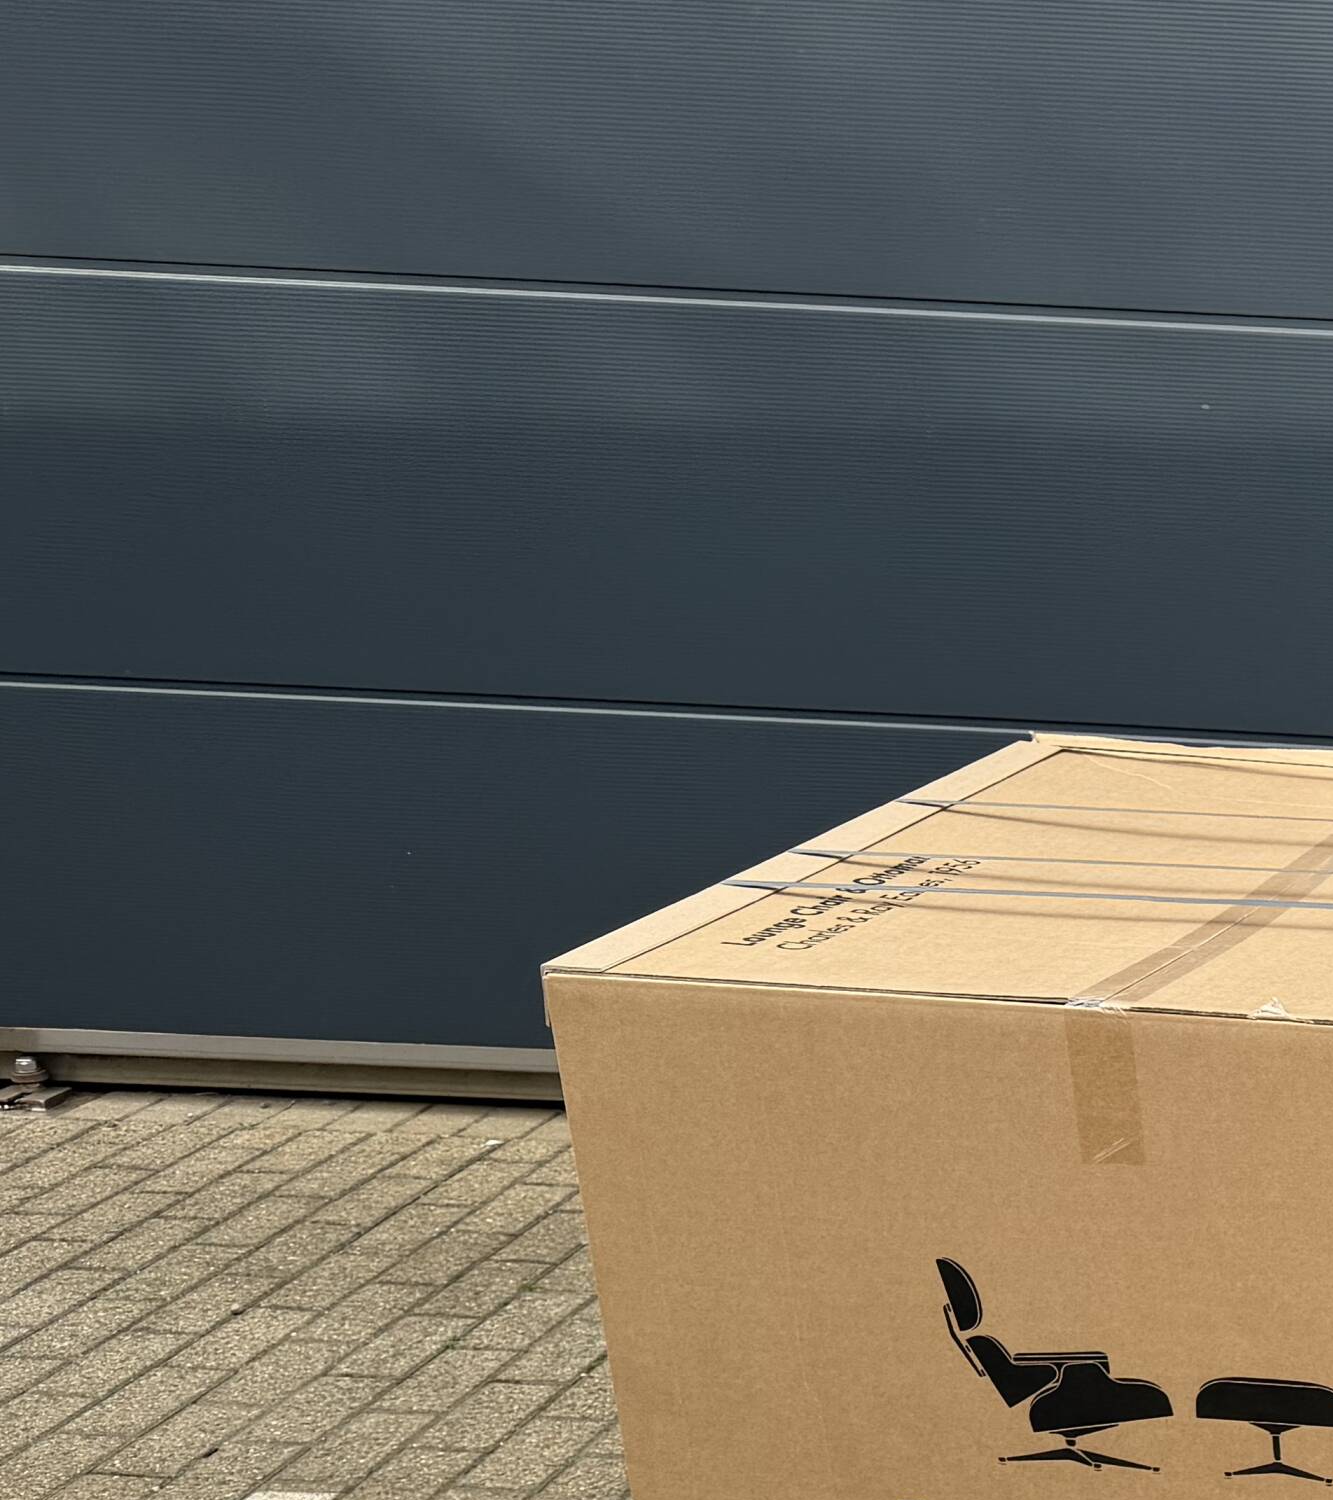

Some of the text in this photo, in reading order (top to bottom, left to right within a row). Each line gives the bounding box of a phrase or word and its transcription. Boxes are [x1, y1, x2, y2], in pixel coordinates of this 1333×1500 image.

[720, 917, 807, 946] Lounge
[789, 894, 853, 915] Chair
[776, 924, 856, 950] Charles
[851, 901, 905, 916] Ray
[927, 858, 981, 876] 1956
